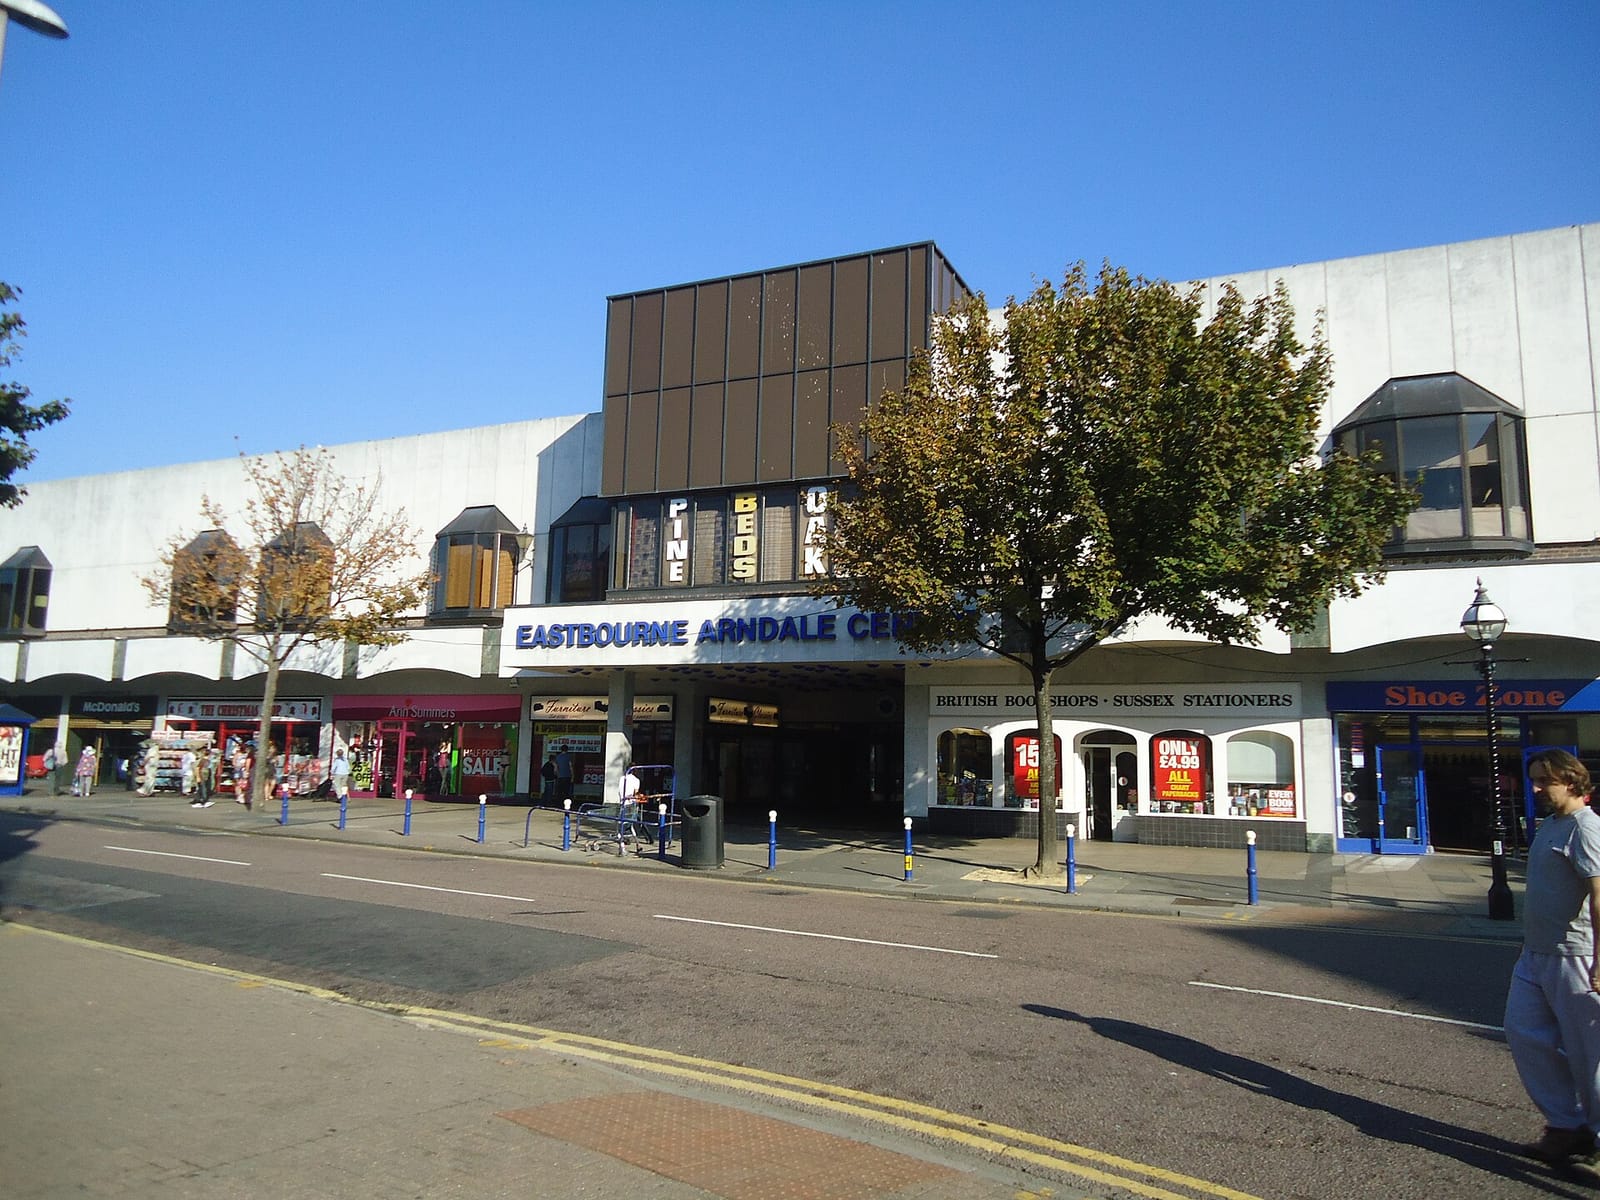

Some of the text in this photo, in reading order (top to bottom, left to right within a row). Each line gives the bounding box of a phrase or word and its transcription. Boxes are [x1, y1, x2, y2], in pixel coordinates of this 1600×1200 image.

[732, 492, 758, 579] BEDS
[804, 486, 829, 575] OAK
[666, 498, 689, 582] PINE
[516, 620, 689, 649] EASTBOURNE
[696, 613, 837, 645] ARNDALE
[936, 694, 1293, 707] BRITISH BOOSHOPS SUSSEX STATIONERS
[1385, 686, 1466, 707] Shoe
[83, 701, 141, 713] McDonald's
[201, 704, 215, 716] THE
[388, 704, 456, 718] Ann Summers
[546, 699, 592, 714] Furniture
[463, 748, 501, 758] HALF PRICE
[1159, 740, 1199, 756] ONLY
[462, 756, 502, 775] SALE
[1159, 755, 1200, 769] £4.99
[1168, 770, 1192, 782] ALL
